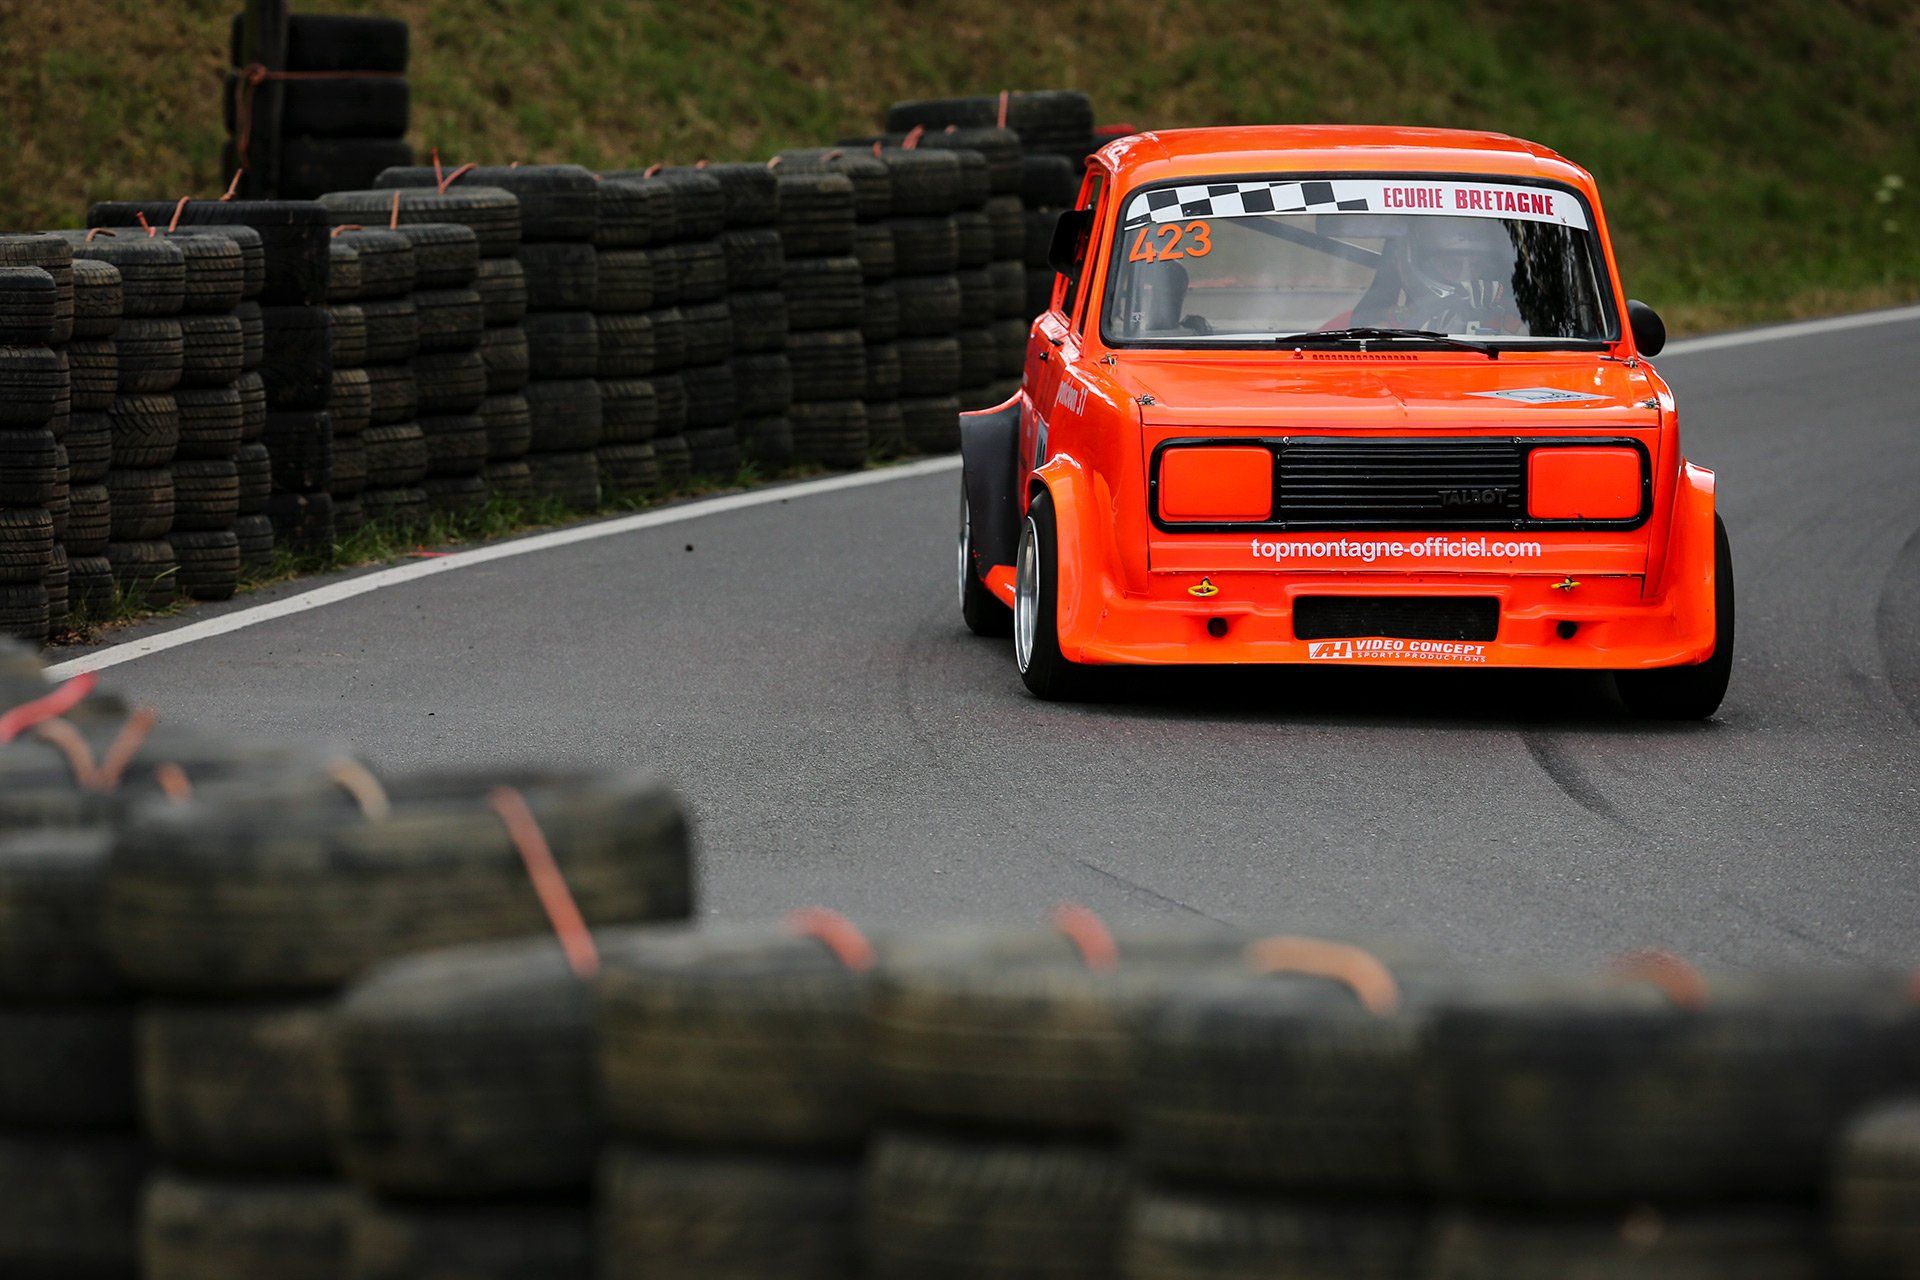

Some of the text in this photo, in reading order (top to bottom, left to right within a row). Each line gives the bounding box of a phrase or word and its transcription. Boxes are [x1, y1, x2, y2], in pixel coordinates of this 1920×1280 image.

[1383, 187, 1554, 216] ECURIE BRETAGNE
[1129, 221, 1213, 264] 423
[1438, 489, 1508, 506] TALBOT
[1251, 537, 1541, 562] topmontagne-officiel.com
[1356, 640, 1404, 651] VIDEO
[1410, 642, 1485, 655] CONCEPT
[1357, 651, 1486, 663] SPORTS PRODUCTIONS
